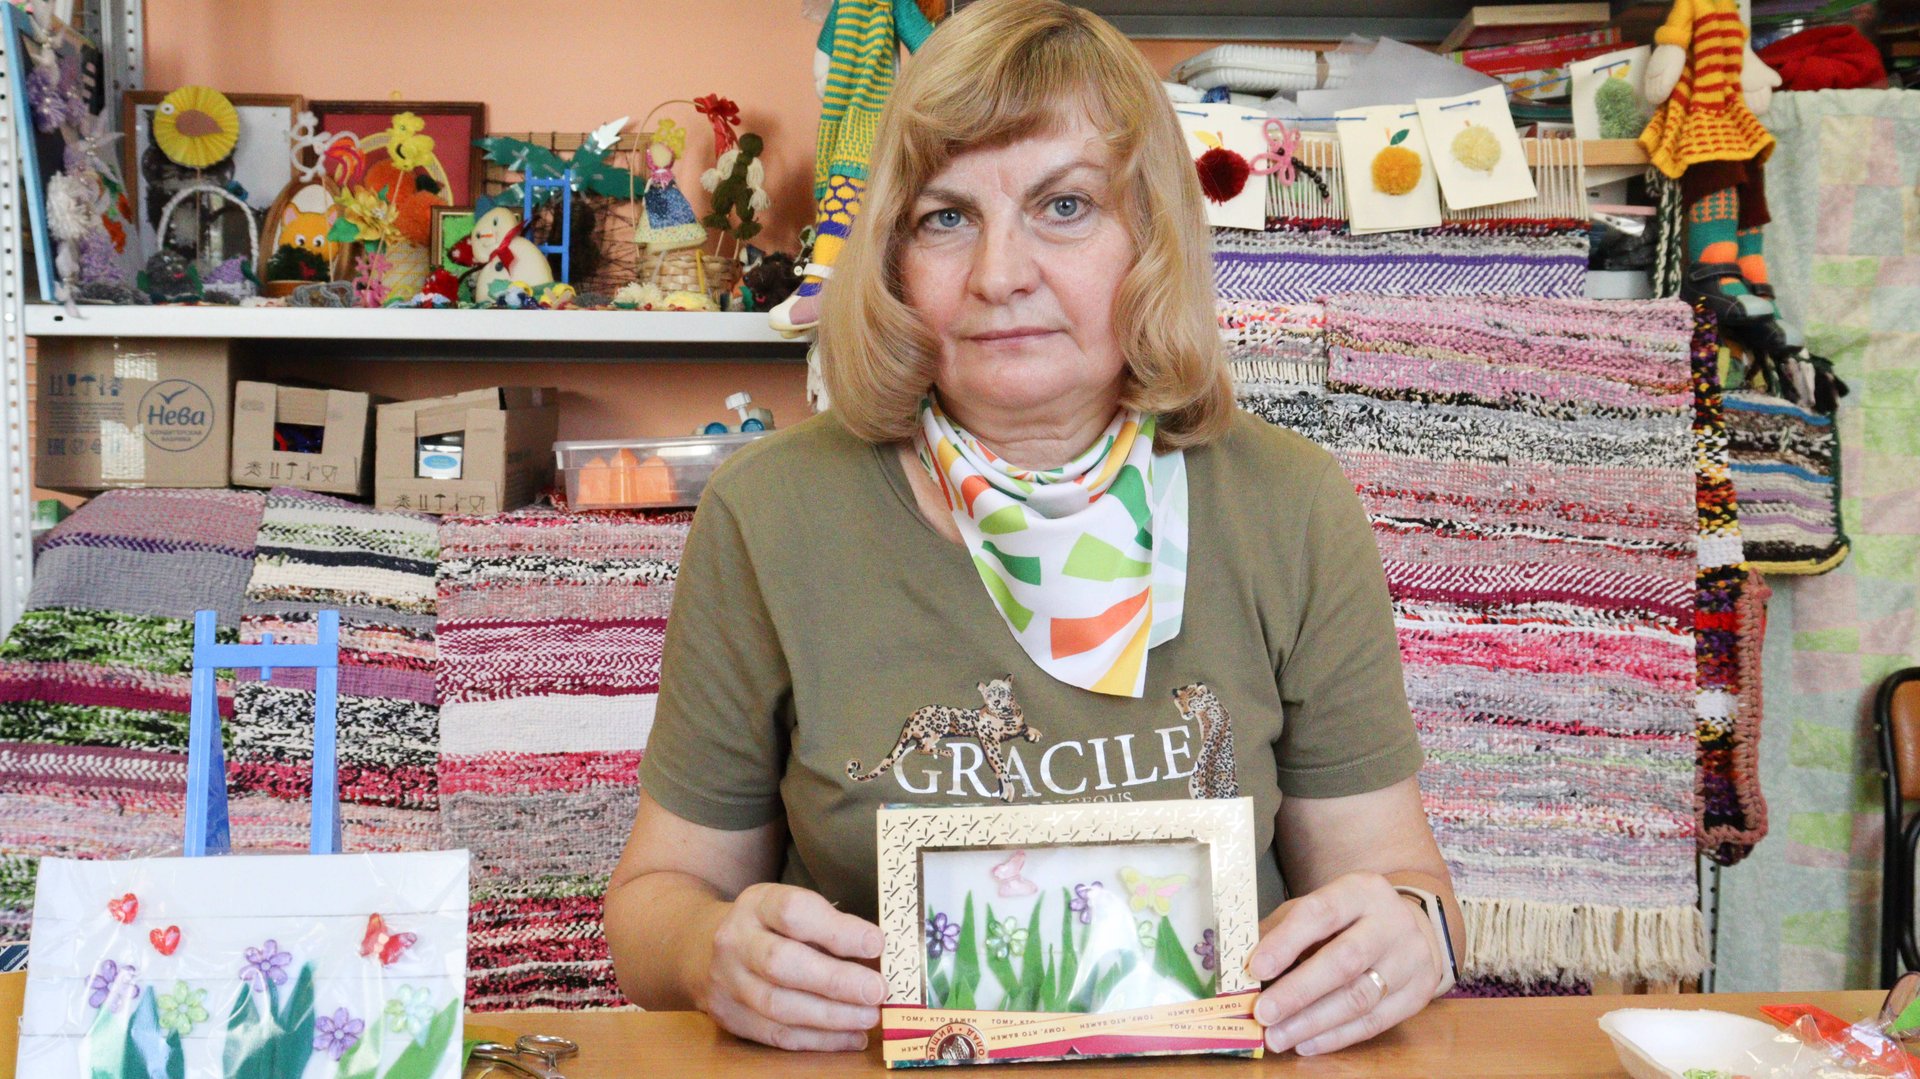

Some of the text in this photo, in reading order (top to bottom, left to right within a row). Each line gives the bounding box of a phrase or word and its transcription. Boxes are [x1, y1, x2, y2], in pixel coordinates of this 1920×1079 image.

[147, 404, 205, 426] Нева
[893, 725, 1199, 798] GRACILE
[991, 1032, 1019, 1040] ВАЖЕН
[901, 1044, 927, 1052] АЖЕН
